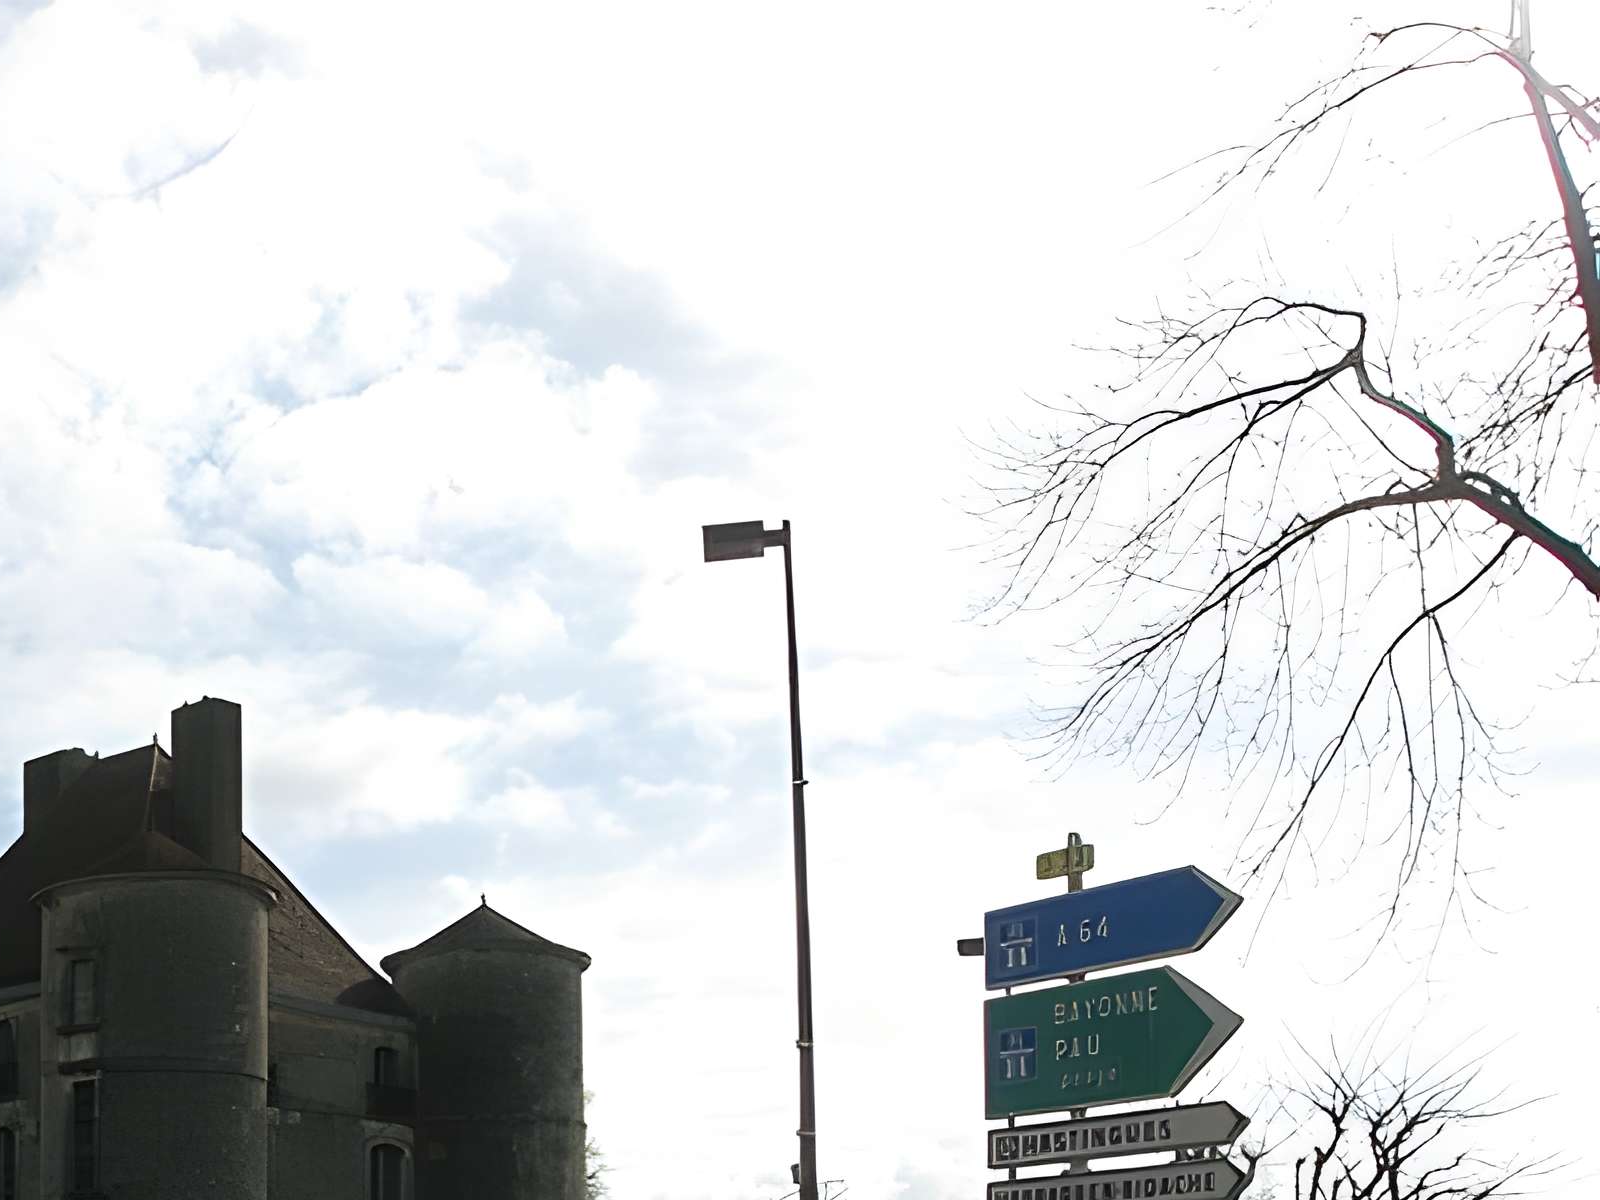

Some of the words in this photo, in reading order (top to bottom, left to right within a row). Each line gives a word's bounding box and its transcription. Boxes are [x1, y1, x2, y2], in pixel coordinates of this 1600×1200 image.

[1057, 924, 1068, 946] A
[1079, 915, 1110, 943] 64
[1054, 986, 1159, 1025] BAYONNE
[1054, 1032, 1102, 1062] PAU
